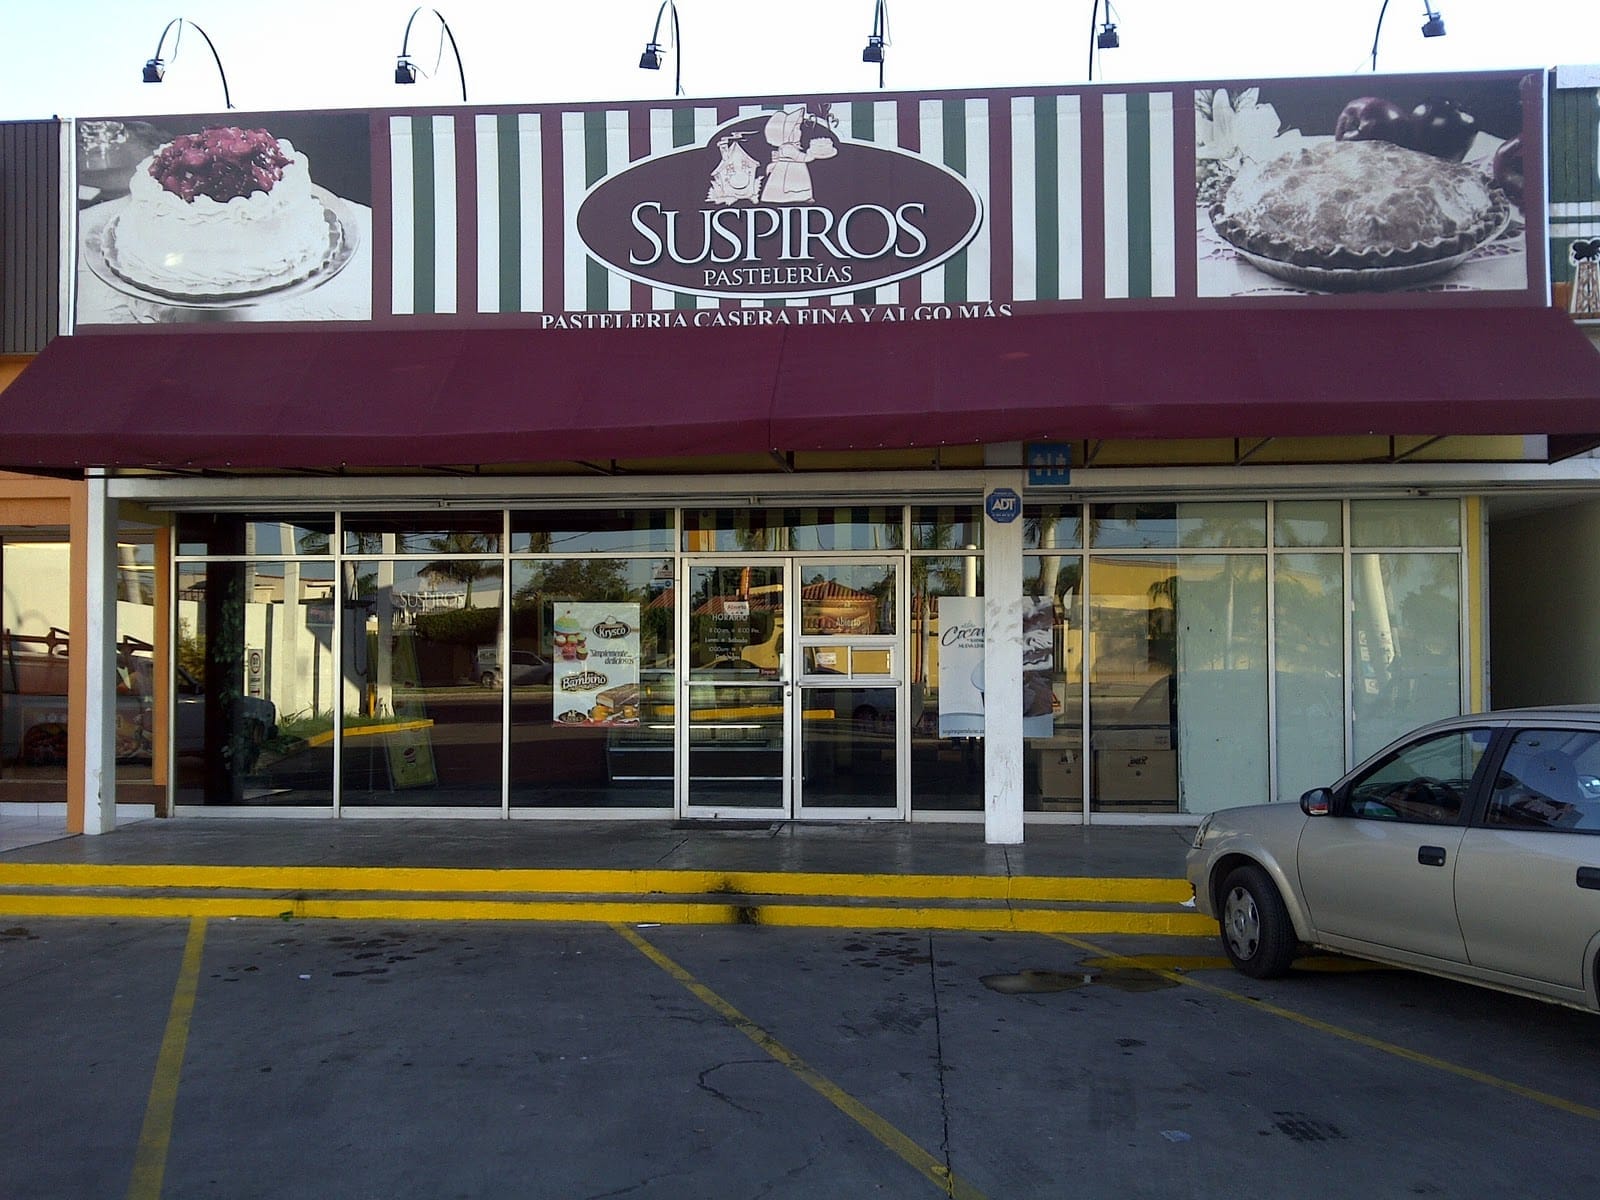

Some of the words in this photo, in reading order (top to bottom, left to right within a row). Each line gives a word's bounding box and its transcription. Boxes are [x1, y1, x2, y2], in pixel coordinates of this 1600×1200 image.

[628, 201, 928, 265] SUSPIROS
[703, 263, 854, 287] PASTELERÍAS
[541, 313, 688, 329] PASTELERIA
[694, 309, 790, 327] CASERA
[797, 308, 855, 325] FINA
[859, 307, 877, 322] Y
[881, 305, 951, 322] ALGO
[959, 300, 1013, 318] MÁS
[992, 498, 1016, 511] ADT
